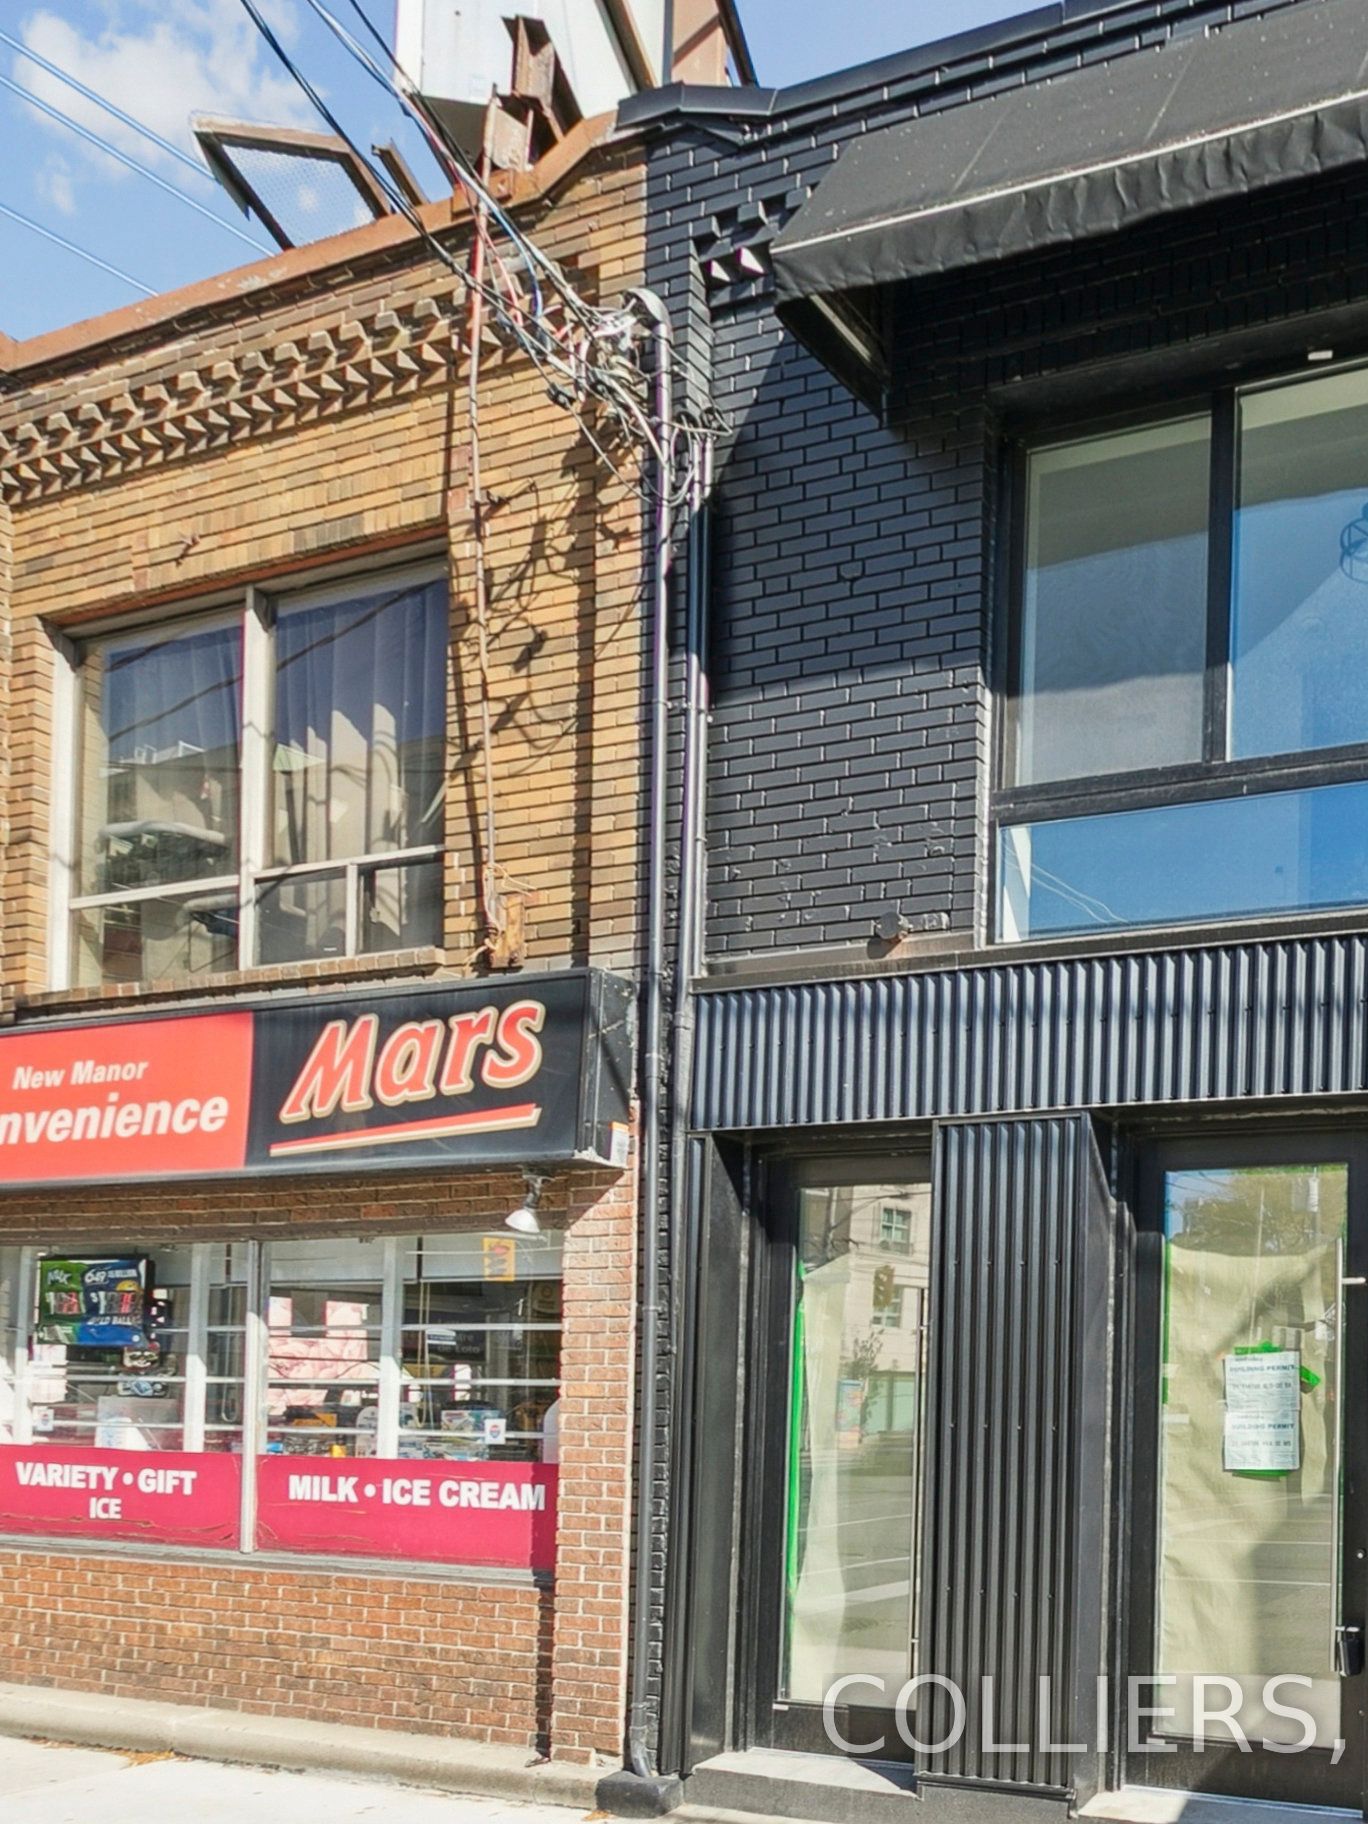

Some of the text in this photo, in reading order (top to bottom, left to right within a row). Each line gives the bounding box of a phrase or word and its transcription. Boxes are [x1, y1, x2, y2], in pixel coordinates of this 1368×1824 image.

[13, 1059, 148, 1089] New Manor
[279, 1000, 545, 1124] Mars
[0, 1092, 229, 1146] nvenience
[16, 1462, 197, 1496] VARIETY GIFT
[288, 1474, 546, 1512] MILK ICE CREAM
[89, 1497, 122, 1520] ICE
